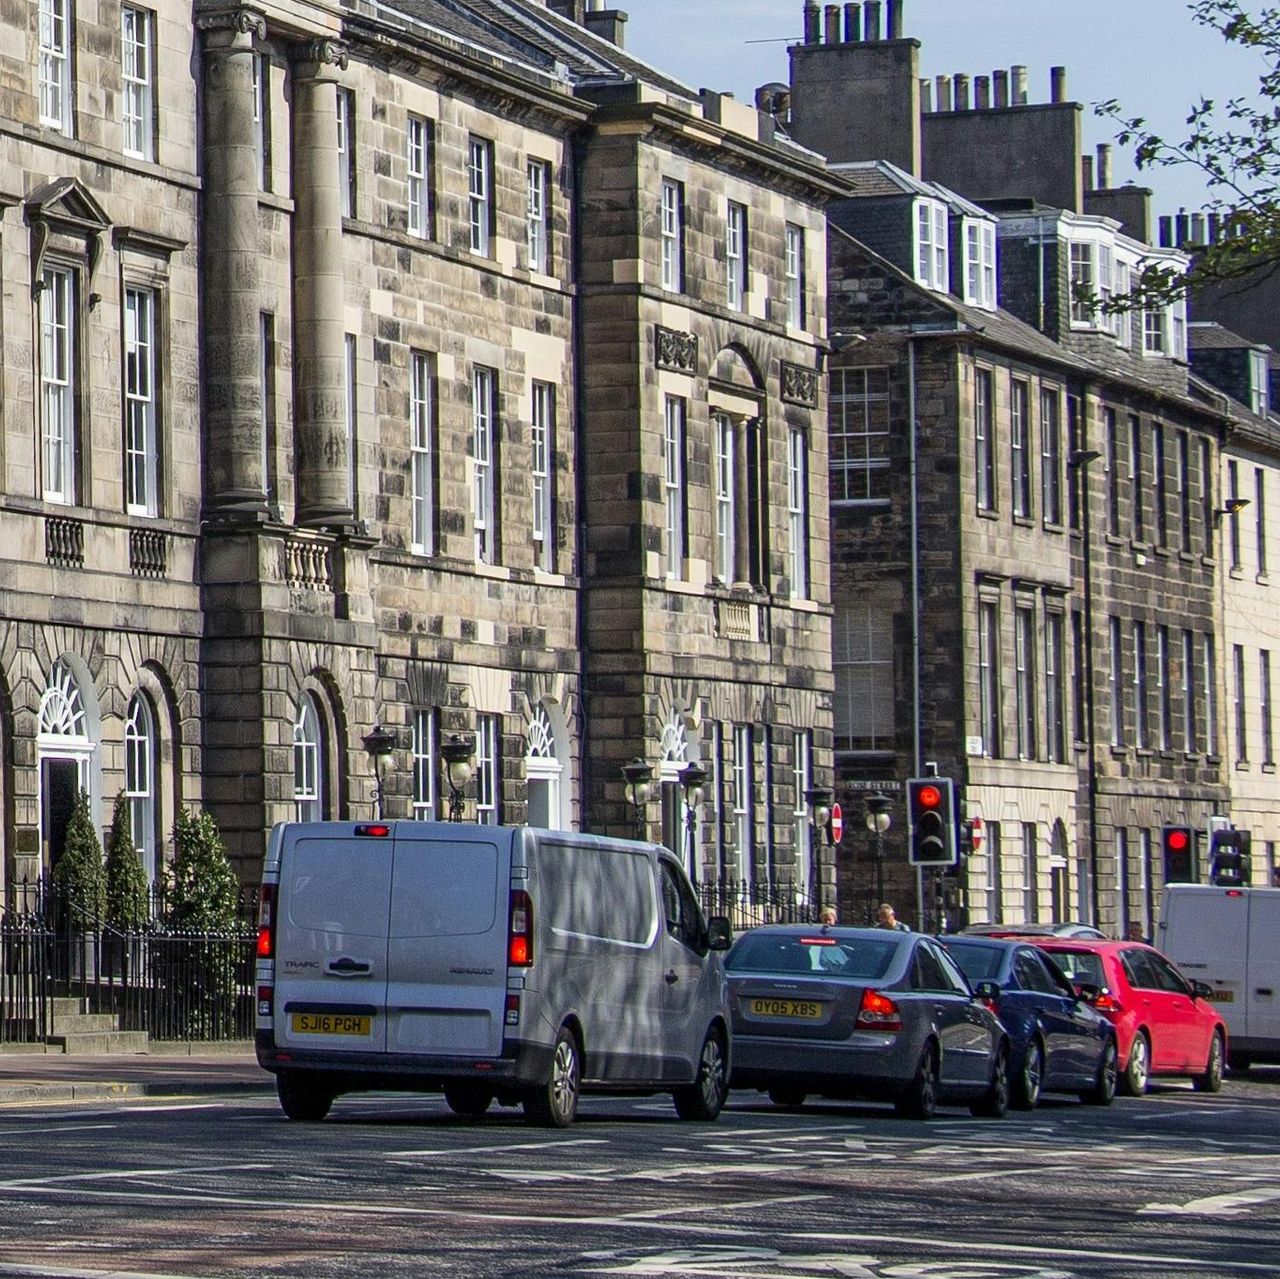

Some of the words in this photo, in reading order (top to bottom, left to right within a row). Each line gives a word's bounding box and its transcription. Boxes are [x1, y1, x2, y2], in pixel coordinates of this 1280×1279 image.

[283, 960, 320, 968] TRAFIC
[755, 1000, 788, 1014] OY05
[791, 1002, 817, 1016] XBS
[301, 1016, 330, 1030] SJ16
[334, 1017, 361, 1032] PGH
